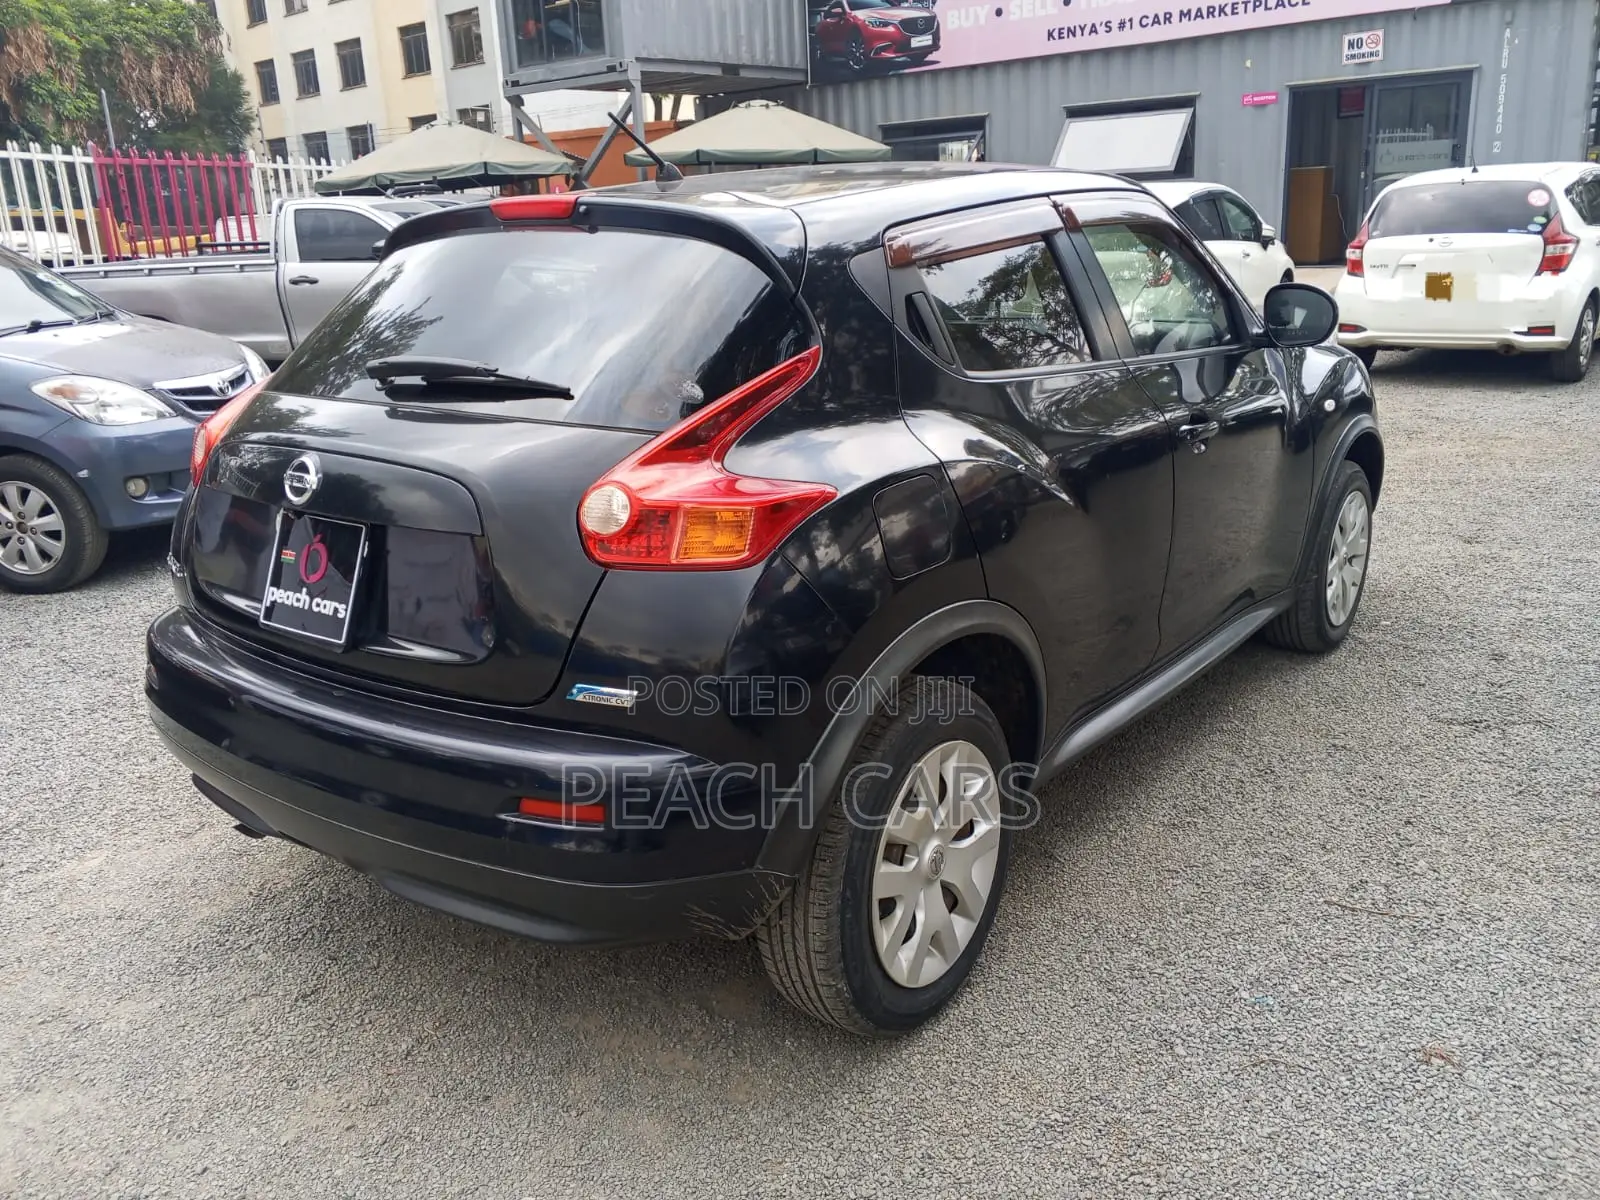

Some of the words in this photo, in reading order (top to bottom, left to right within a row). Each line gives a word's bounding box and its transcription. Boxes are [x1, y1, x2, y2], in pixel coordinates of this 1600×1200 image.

[947, 6, 990, 30] BUY
[1009, 0, 1059, 20] SELL
[1047, 20, 1112, 41] KENYA'S
[1118, 17, 1133, 32] #1
[1139, 12, 1173, 28] CAR
[1347, 37, 1364, 50] NO
[1345, 50, 1380, 61] SMOKING
[266, 586, 310, 610] peach
[311, 596, 347, 619] cars
[583, 694, 614, 704] XTRONIC
